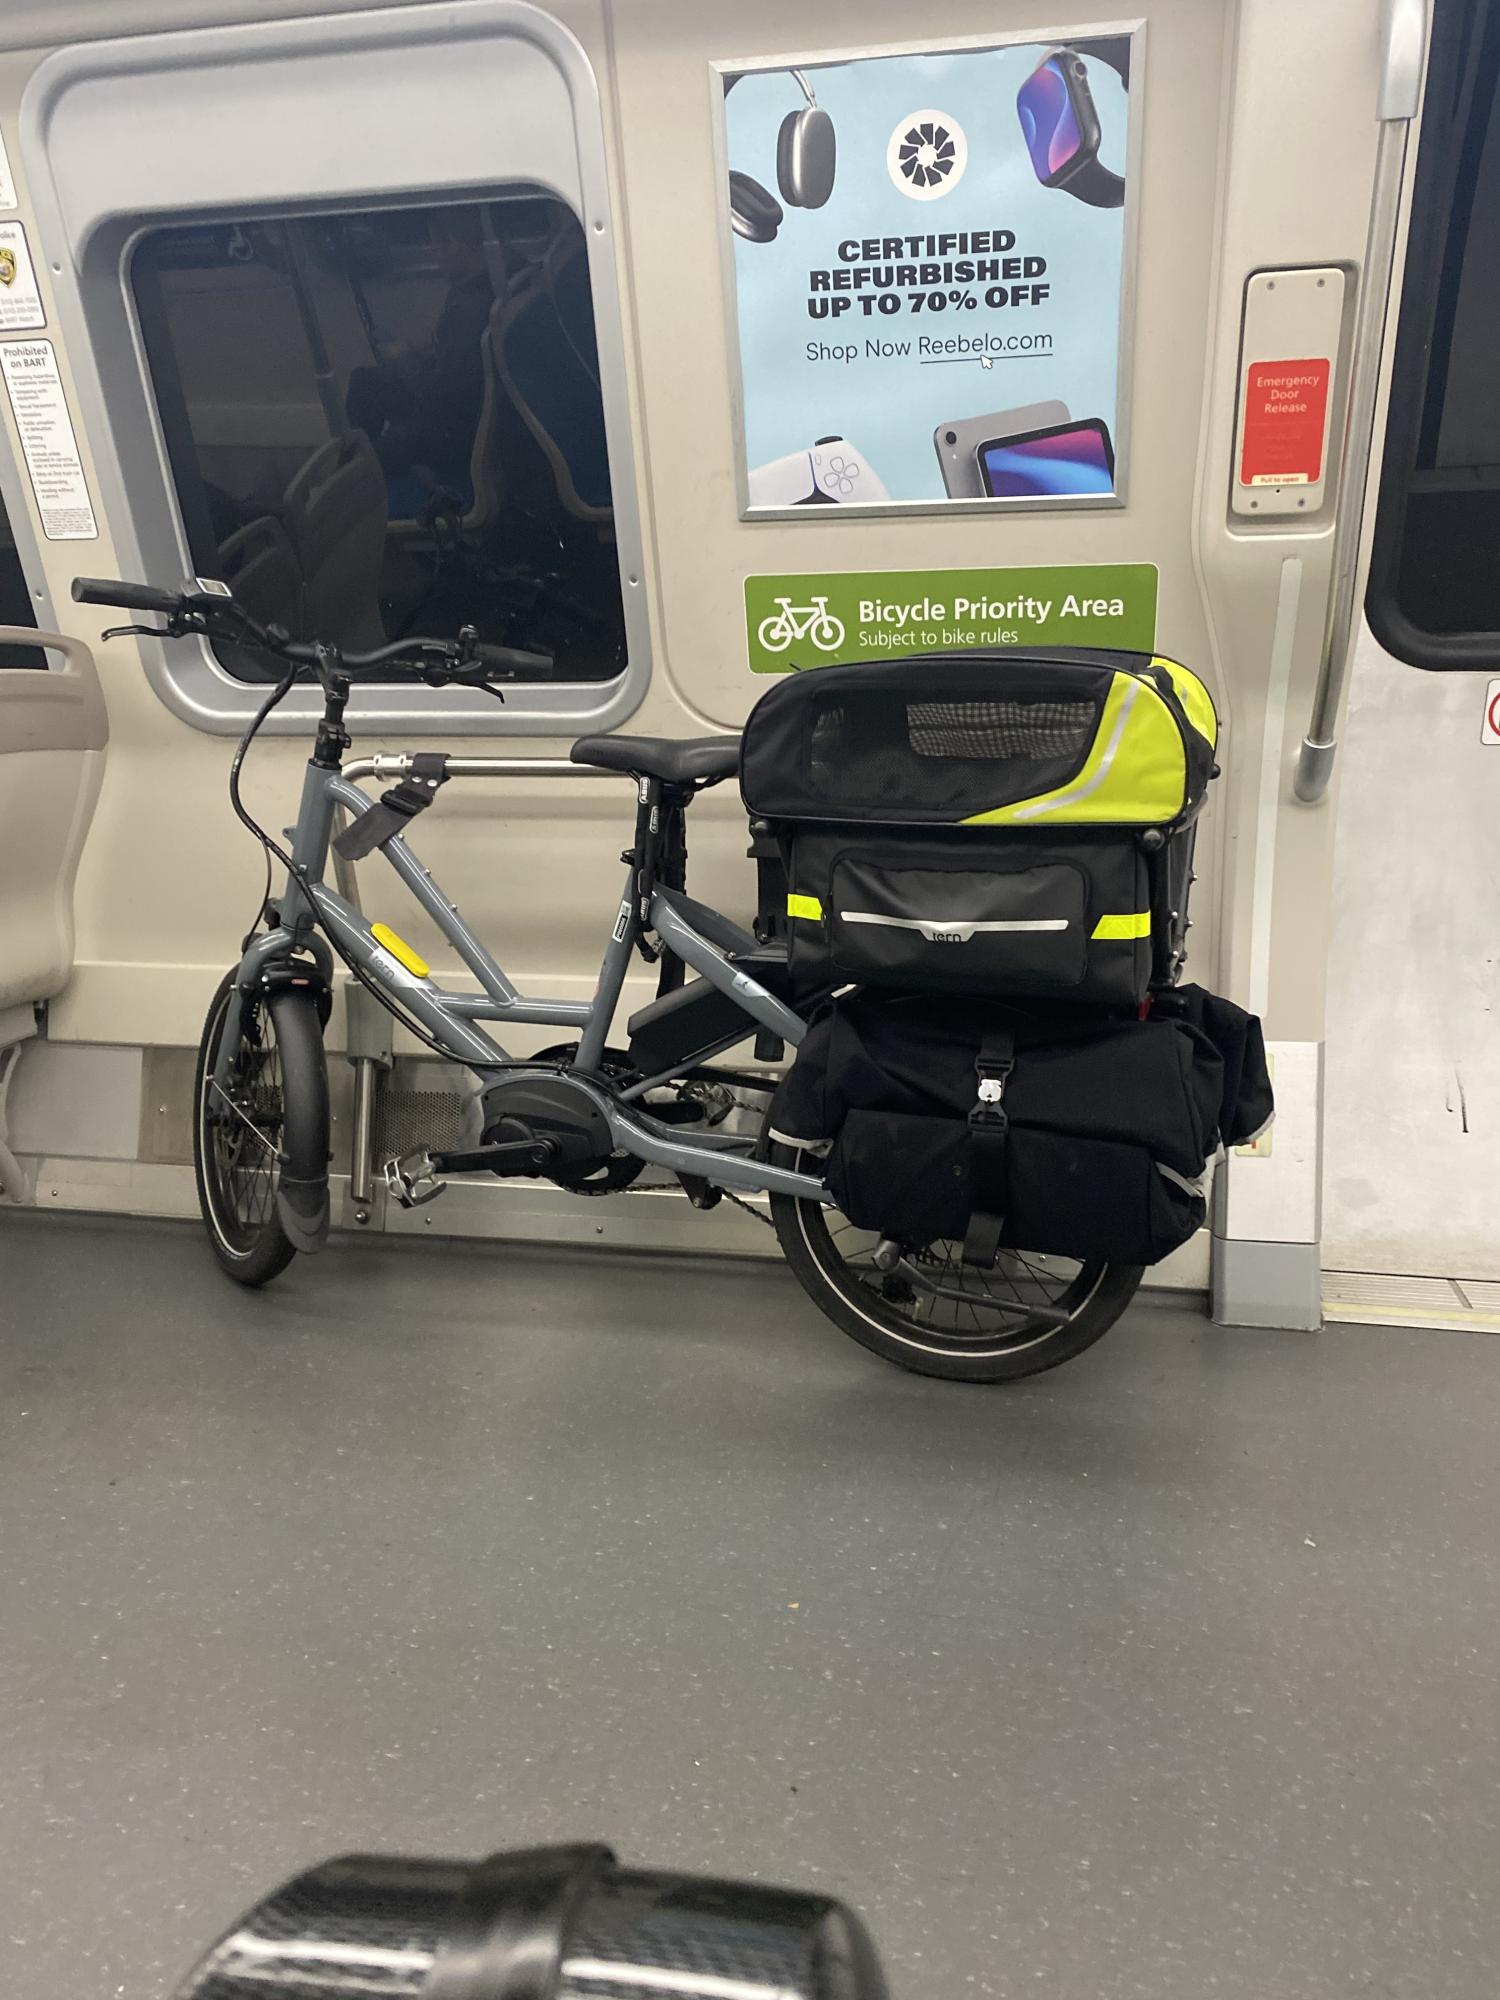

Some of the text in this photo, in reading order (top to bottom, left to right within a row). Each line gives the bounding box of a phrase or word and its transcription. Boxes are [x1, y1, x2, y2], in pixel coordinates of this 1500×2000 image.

[838, 229, 1016, 262] CERTIFIED
[809, 256, 1047, 292] REFURBISHED
[807, 284, 1050, 319] UP TO 70% OFF
[3, 345, 48, 357] Prohibited
[806, 332, 1053, 364] Shop Now Reebelo.com
[23, 357, 46, 367] BART
[1256, 375, 1319, 388] Emergency
[1270, 389, 1300, 401] Door
[1264, 403, 1307, 414] Release
[859, 594, 1124, 628] Bicycle Priority Area
[858, 627, 1018, 650] Subject to bike rules
